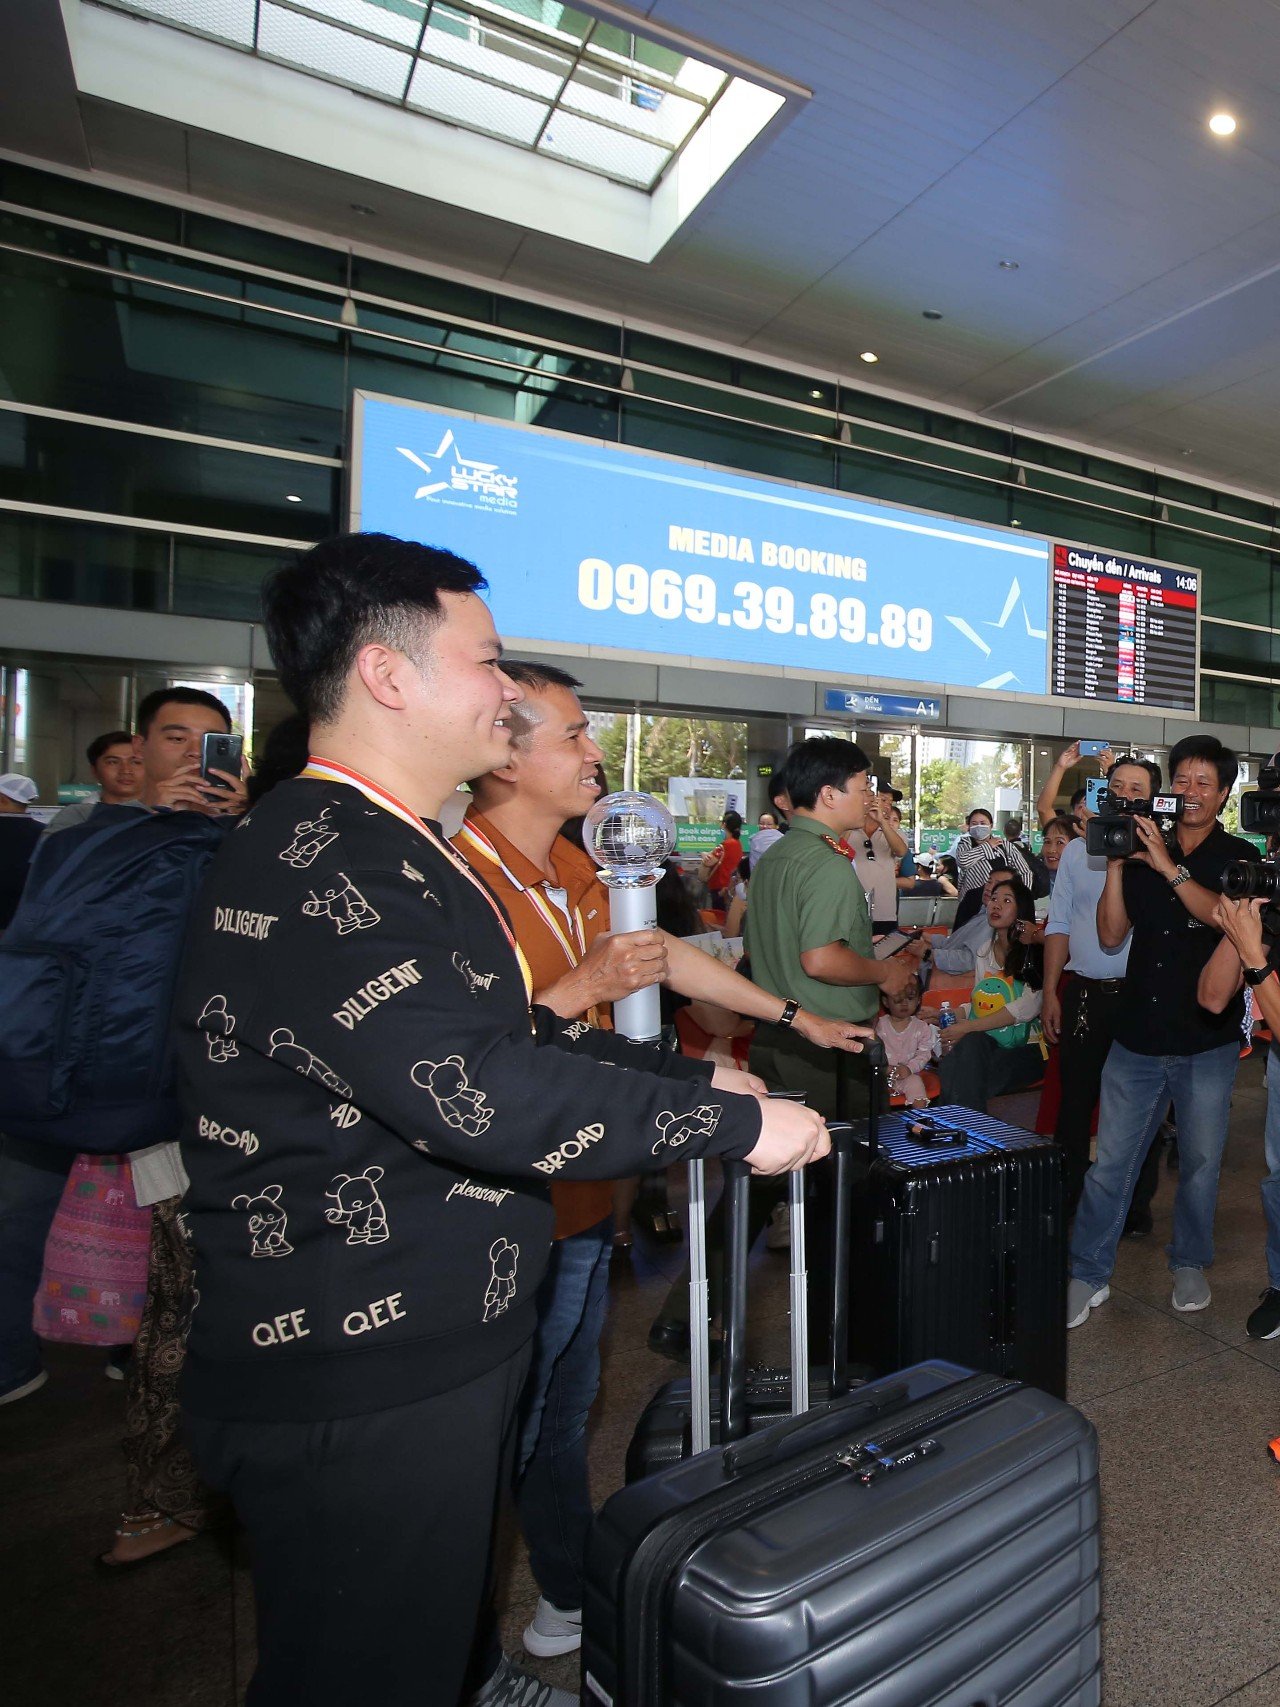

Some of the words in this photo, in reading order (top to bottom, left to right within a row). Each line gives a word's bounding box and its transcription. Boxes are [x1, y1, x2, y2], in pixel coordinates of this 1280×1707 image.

[451, 465, 518, 487] LUCKY
[451, 477, 518, 499] STAR
[479, 495, 518, 508] media
[668, 525, 754, 564] MEDIA
[761, 541, 867, 582] BOOKING
[1128, 564, 1162, 585] Arrivals
[1175, 575, 1197, 592] 14:06
[578, 557, 933, 652] 0969.39.89.89
[915, 701, 934, 716] A1
[1156, 798, 1175, 808] BTV
[679, 827, 700, 835] Book
[921, 832, 946, 842] Grab
[215, 906, 278, 940] DILIGENT
[332, 958, 423, 1030] DILIGENT
[199, 1115, 259, 1156] BROAD
[531, 1122, 605, 1175] BROAD
[446, 1178, 515, 1207] pleasant
[343, 1292, 406, 1336] QEE
[252, 1309, 310, 1347] QEE
